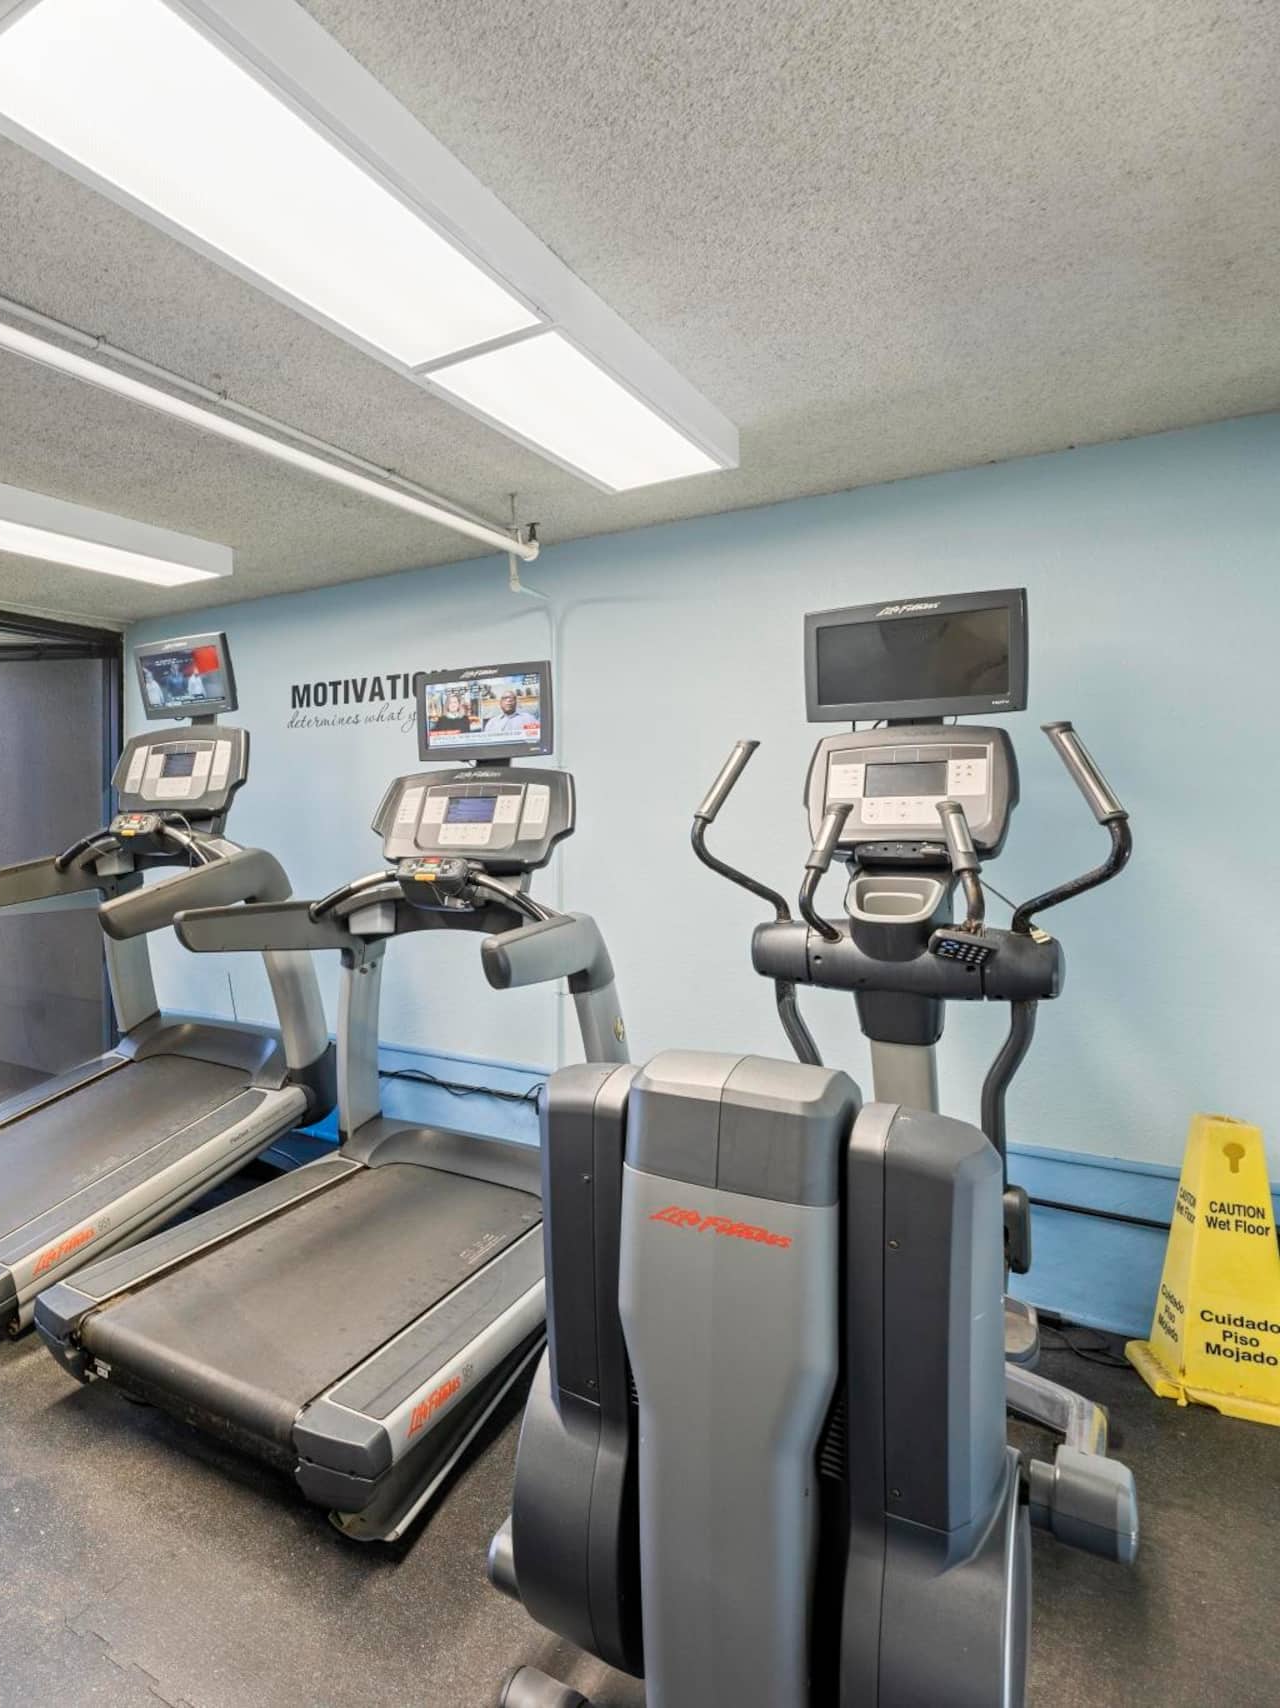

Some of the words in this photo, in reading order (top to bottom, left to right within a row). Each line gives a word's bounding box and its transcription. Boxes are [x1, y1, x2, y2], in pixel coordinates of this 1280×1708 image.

[291, 669, 447, 709] MOTIVATIO
[287, 710, 360, 729] determines
[363, 702, 404, 724] what
[1209, 1200, 1266, 1220] CAUTION
[1205, 1215, 1232, 1232] Wet
[1235, 1219, 1271, 1237] Floor
[1200, 1309, 1280, 1334] Cuidado
[1222, 1329, 1260, 1348] Piso
[1205, 1341, 1278, 1367] Mojado
